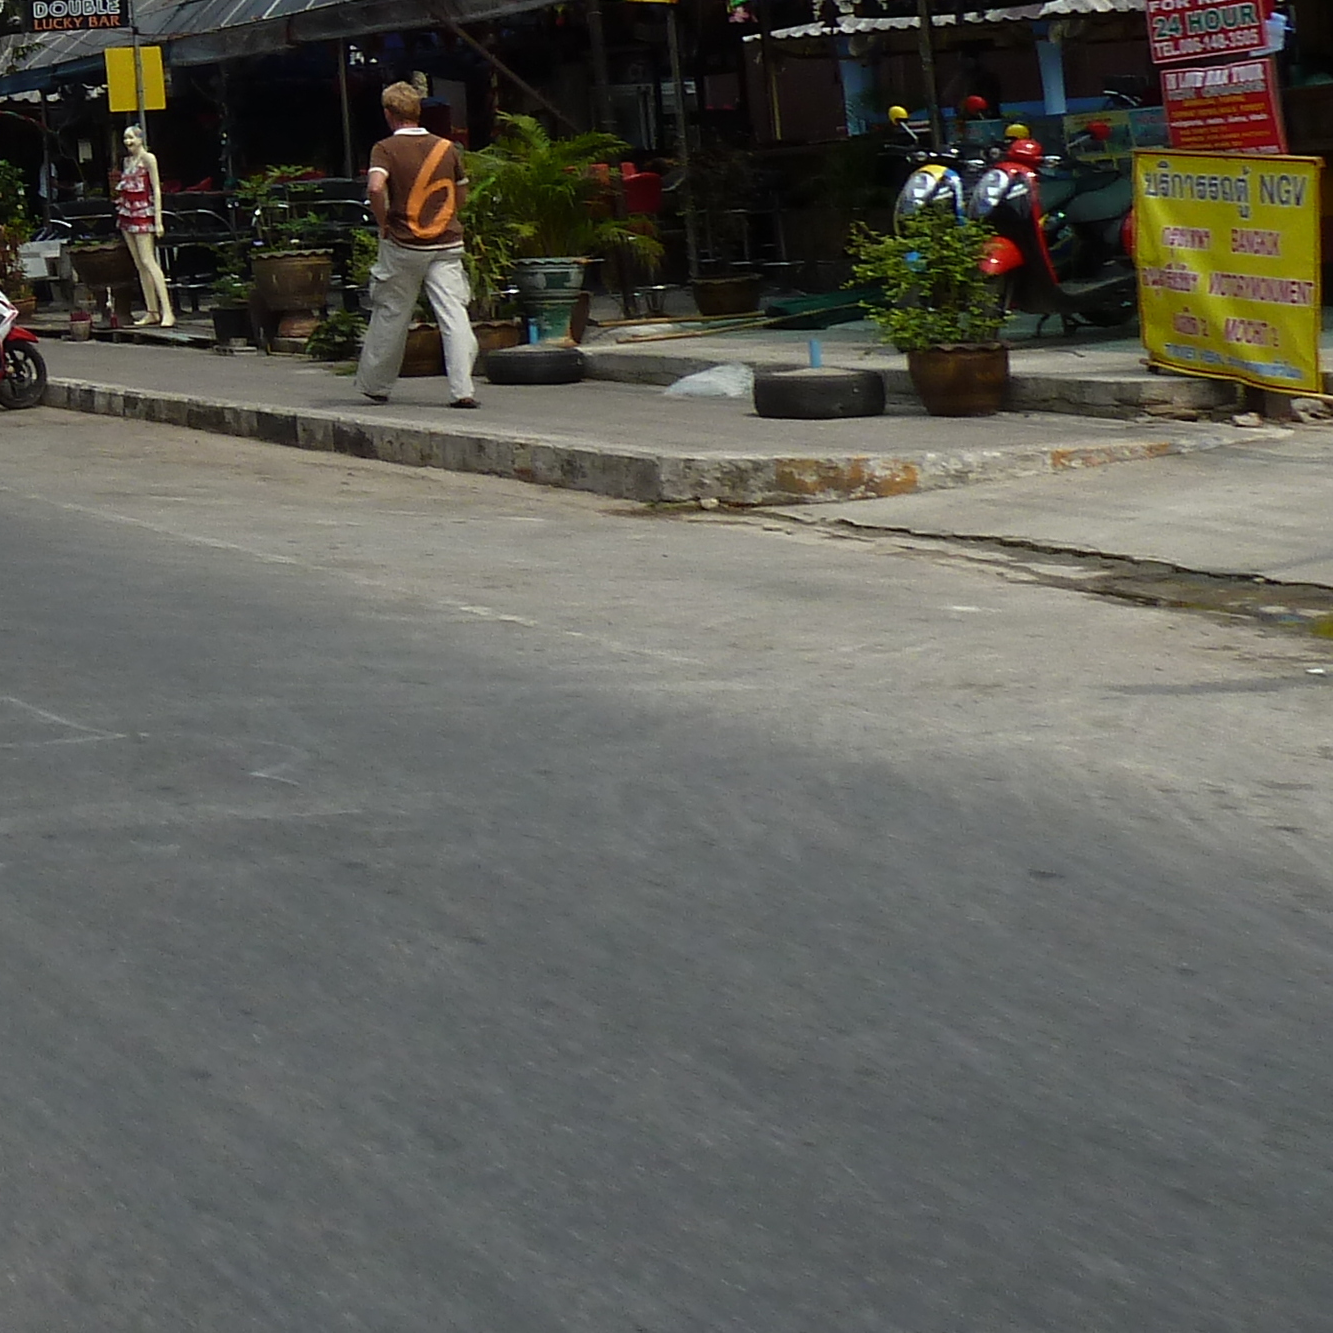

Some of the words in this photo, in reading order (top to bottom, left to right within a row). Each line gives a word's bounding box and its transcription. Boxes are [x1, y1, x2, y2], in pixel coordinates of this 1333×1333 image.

[34, 17, 83, 31] LUCKY
[88, 15, 121, 28] BAR
[1153, 15, 1182, 40] 24
[1186, 3, 1258, 35] HOUR
[406, 137, 457, 239] 6
[1259, 173, 1308, 208] NGV
[1231, 227, 1281, 257] BANGKOK
